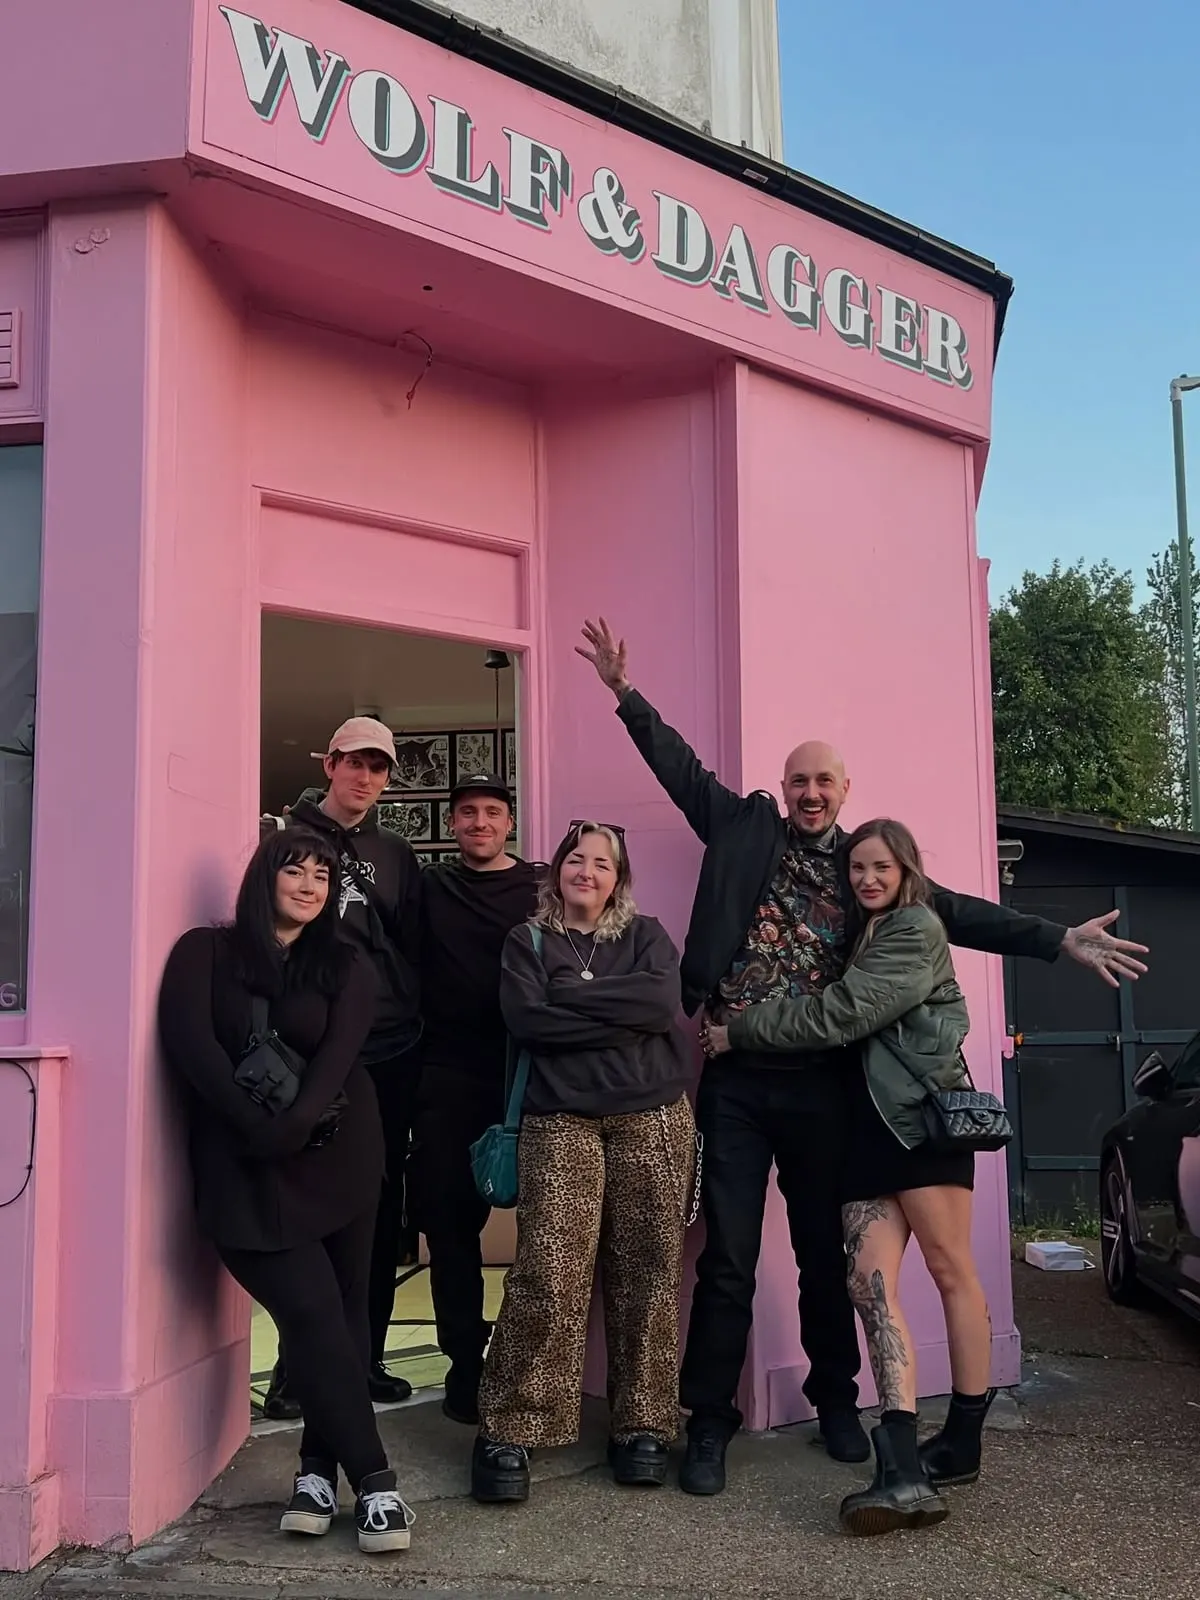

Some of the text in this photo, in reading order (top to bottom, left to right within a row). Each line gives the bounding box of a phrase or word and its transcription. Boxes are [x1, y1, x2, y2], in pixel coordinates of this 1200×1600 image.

[218, 5, 973, 391] WOLF & DAGGER
